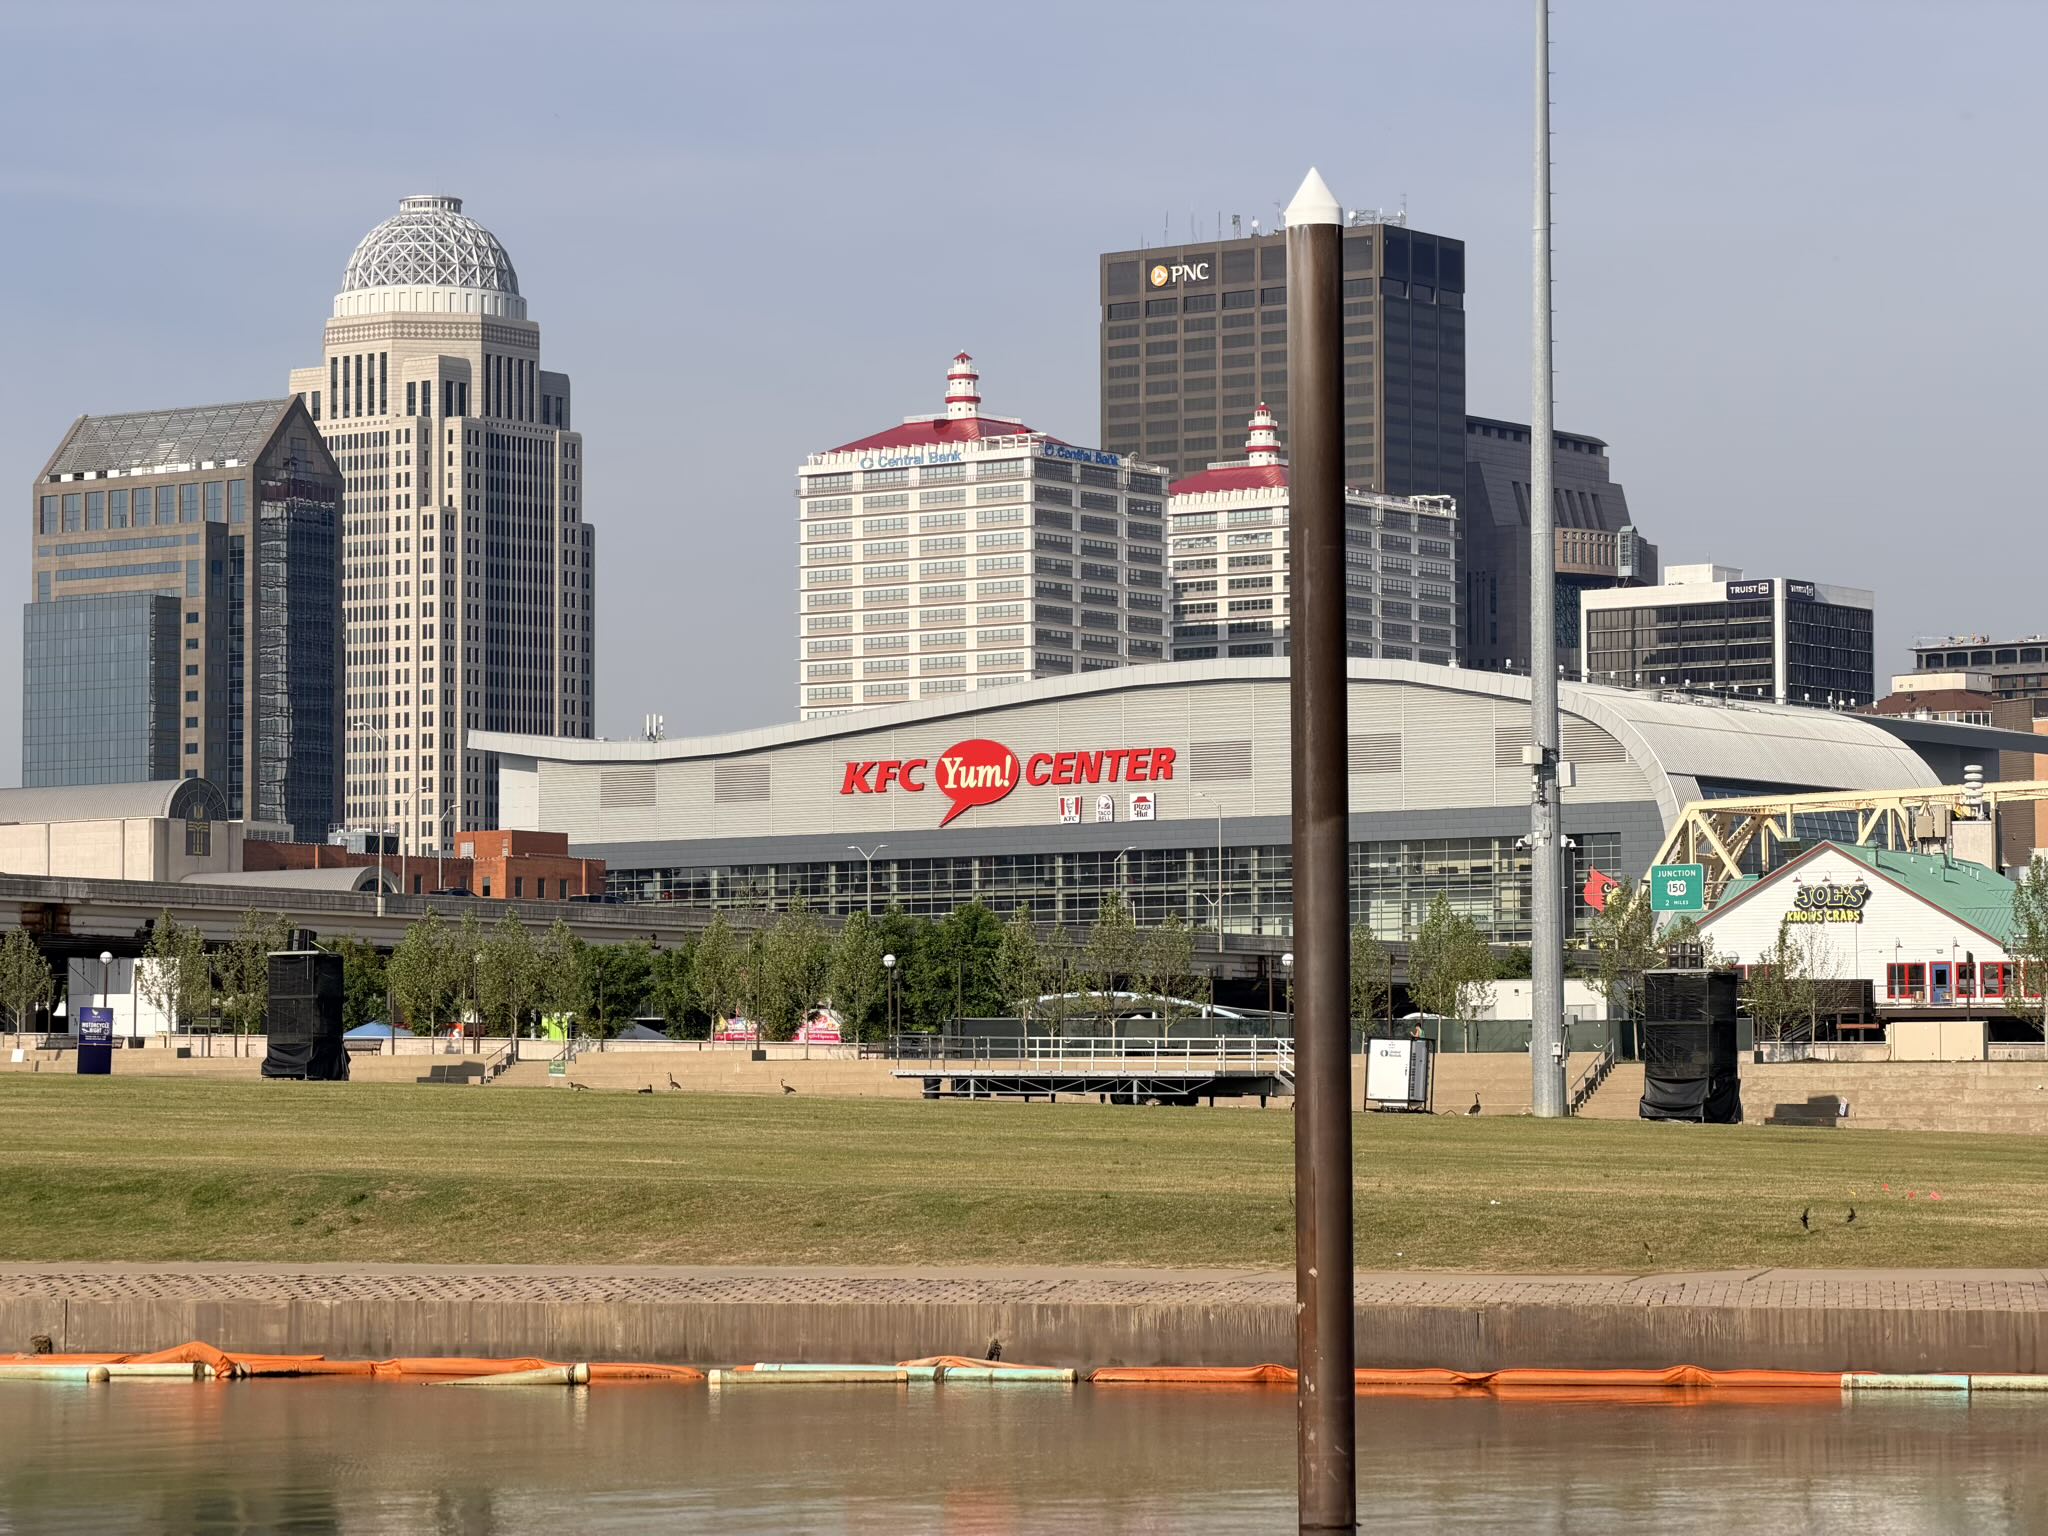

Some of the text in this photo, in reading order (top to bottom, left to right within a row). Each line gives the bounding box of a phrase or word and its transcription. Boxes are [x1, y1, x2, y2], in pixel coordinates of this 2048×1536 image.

[1170, 263, 1209, 282] PNC
[878, 450, 962, 468] Central Bank
[1730, 585, 1758, 594] TRUIST
[840, 747, 1177, 794] KFC Yum! CENTER
[1134, 803, 1151, 811] Pizza
[1669, 883, 1685, 893] 150
[1795, 884, 1869, 910] JOE'S
[1787, 909, 1862, 922] KNOWS CRABS
